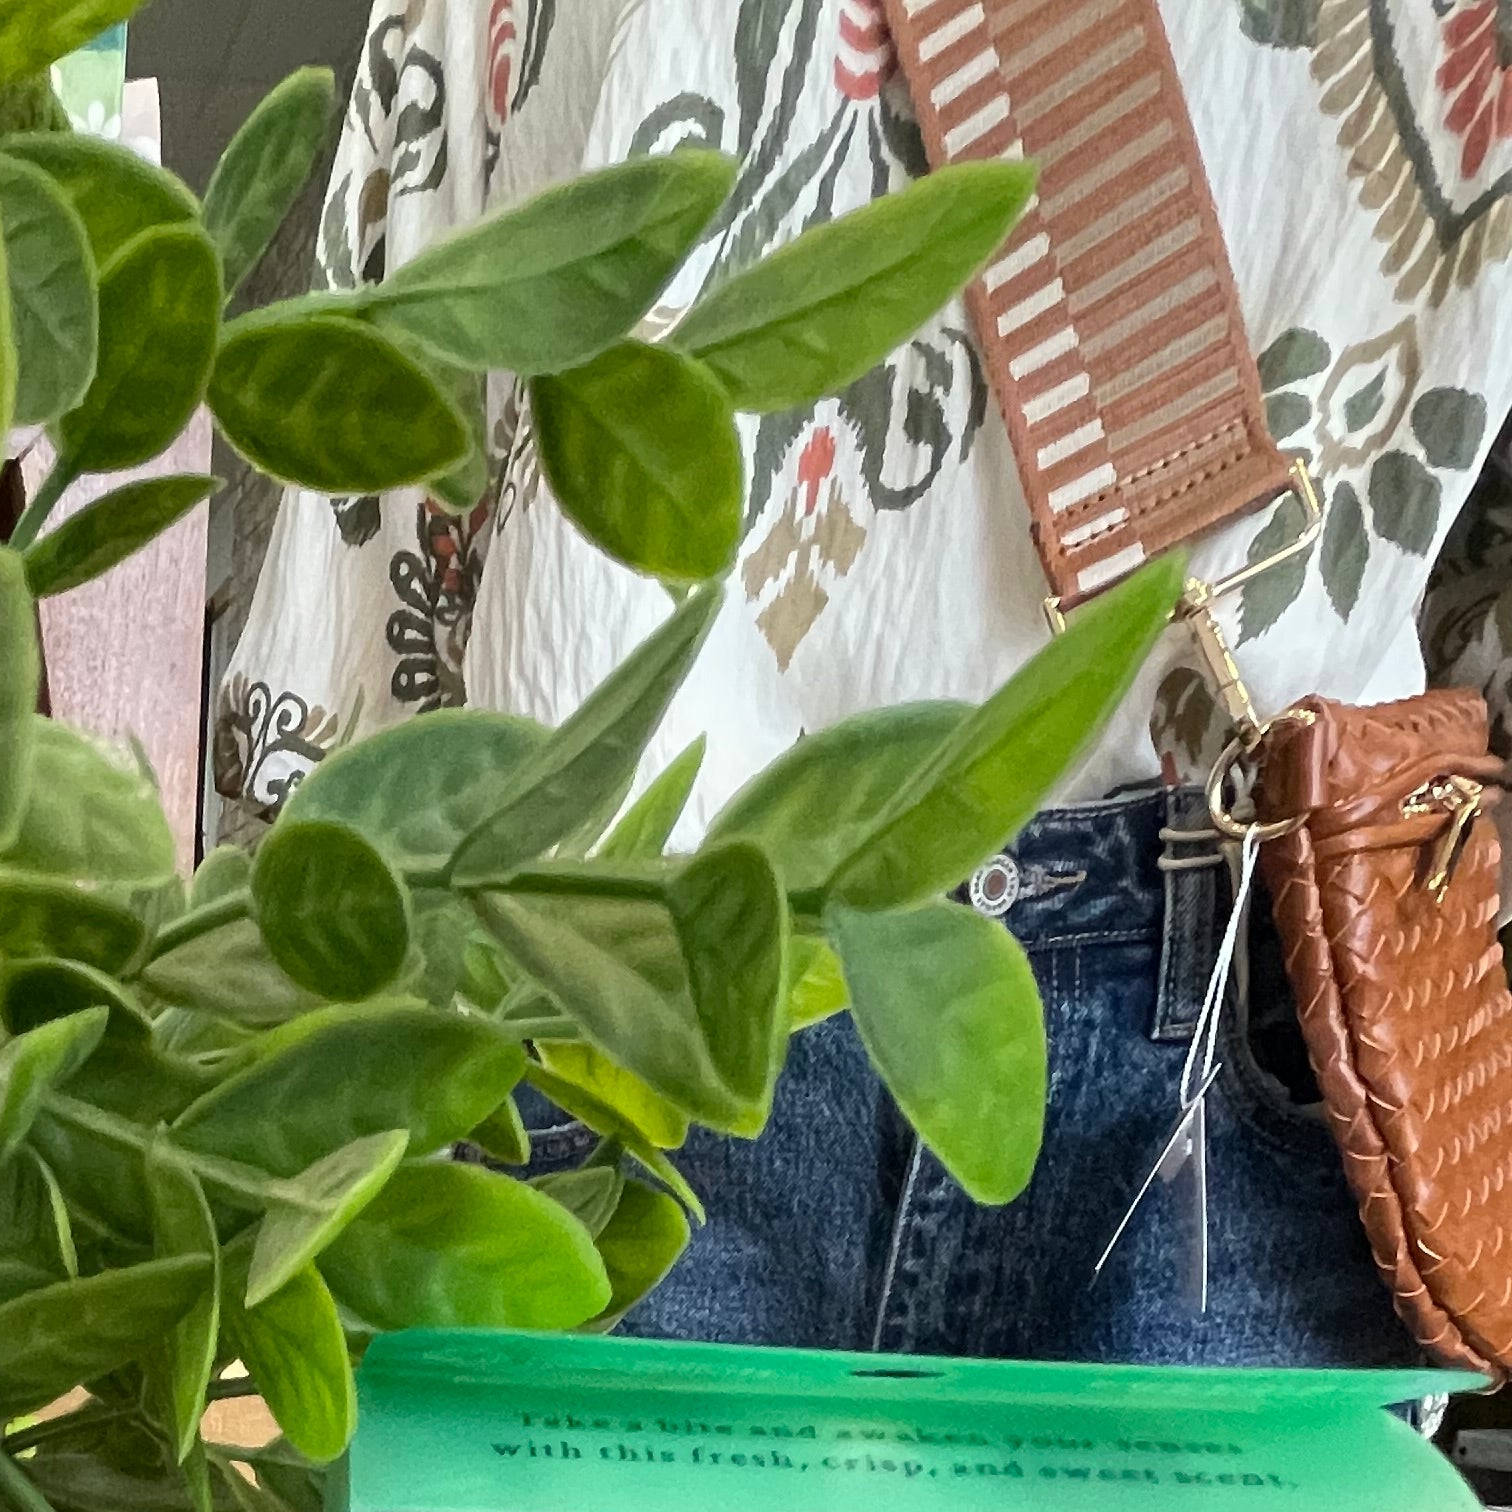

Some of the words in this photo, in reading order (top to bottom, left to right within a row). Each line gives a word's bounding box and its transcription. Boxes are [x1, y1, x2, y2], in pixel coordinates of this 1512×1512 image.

[491, 1440, 581, 1460] with
[598, 1443, 676, 1463] this
[953, 1460, 1024, 1478] and
